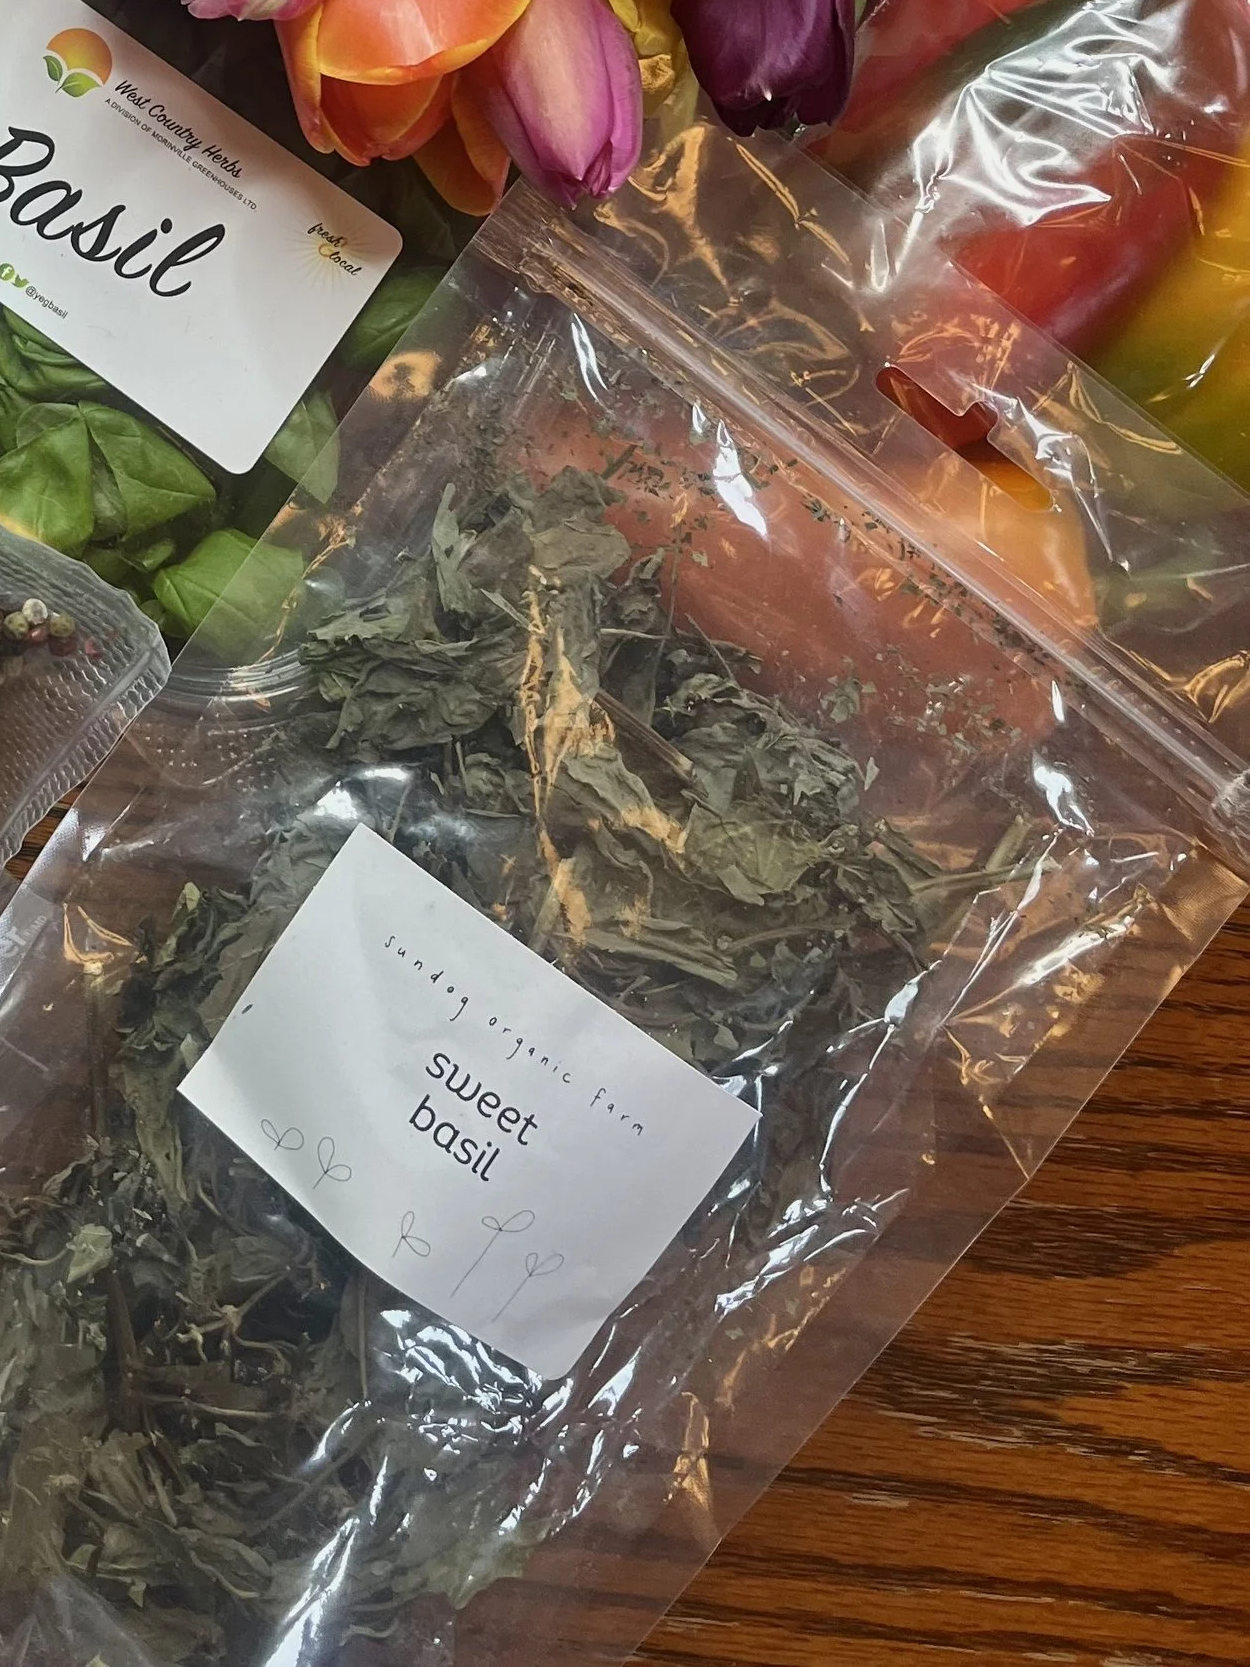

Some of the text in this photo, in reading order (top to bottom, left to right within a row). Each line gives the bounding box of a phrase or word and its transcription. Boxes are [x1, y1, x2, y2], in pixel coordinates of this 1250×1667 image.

[110, 101, 141, 127] DIVISION
[141, 123, 152, 134] OF
[151, 131, 192, 164] MORINVILLE
[192, 161, 243, 201] GREENHOUSES
[115, 80, 243, 179] West Country Herbs
[307, 222, 342, 248] fresh
[329, 251, 362, 276] local
[25, 285, 69, 320] @yegbasil
[384, 935, 643, 1136] sundog organic farm
[408, 1094, 500, 1182] basil
[425, 1052, 538, 1146] sweet
